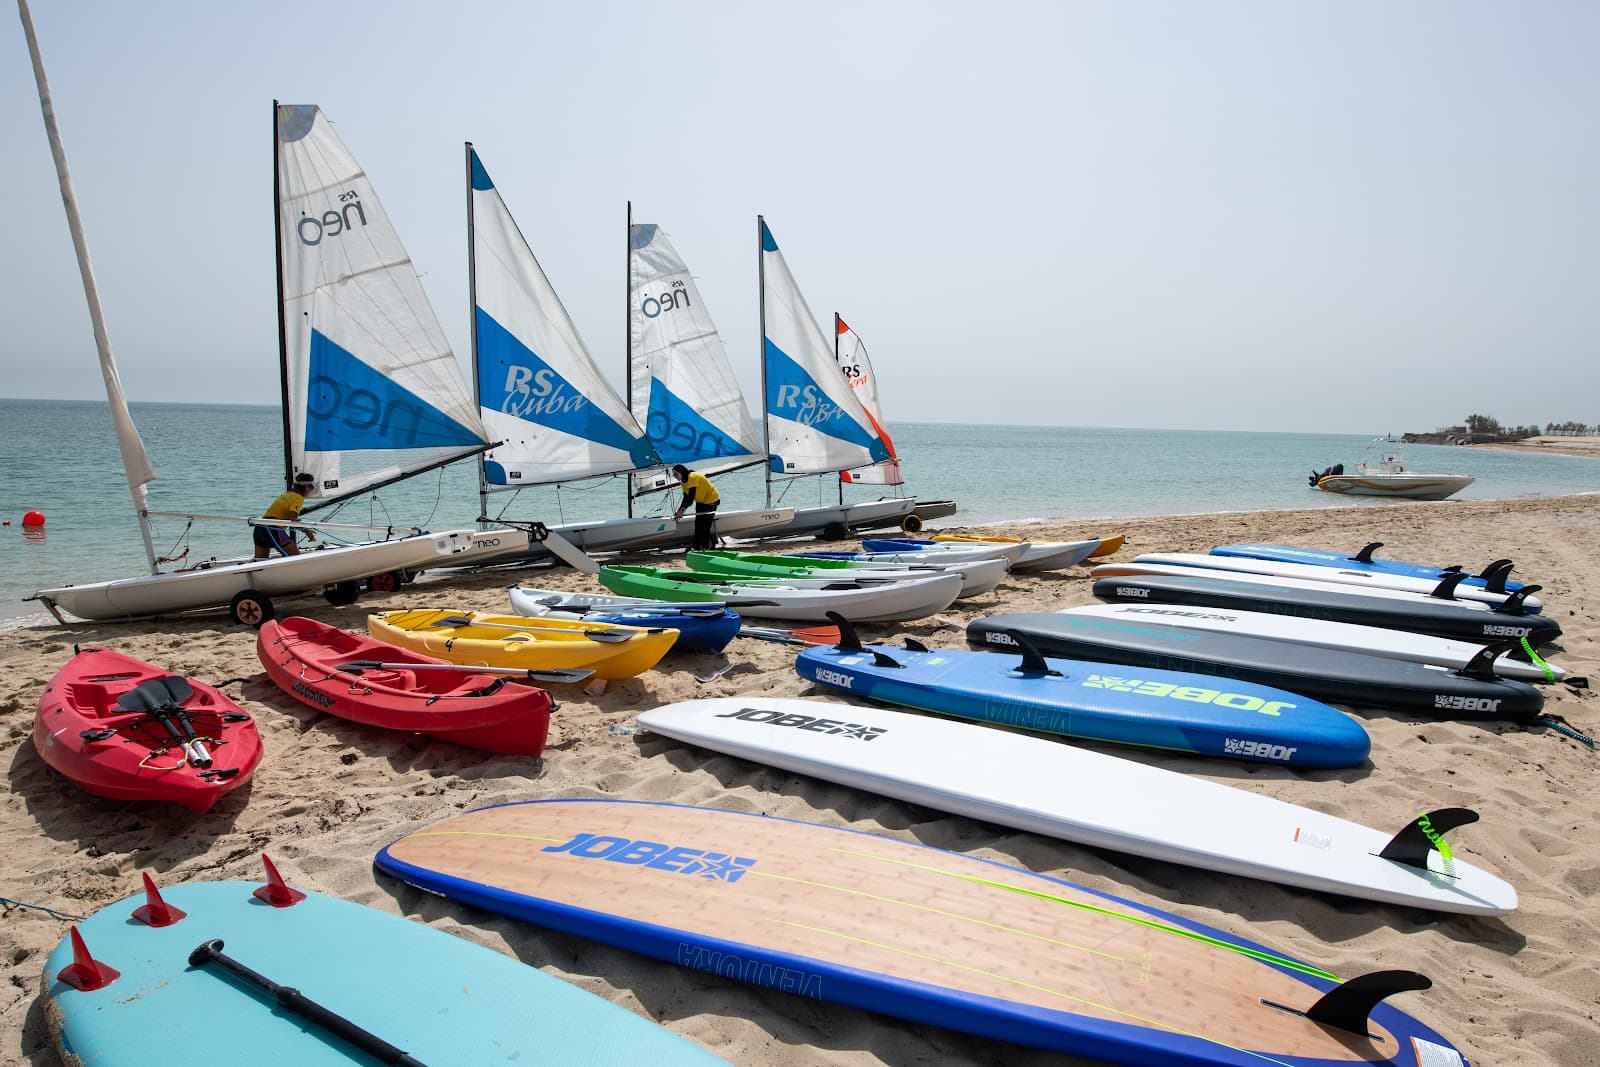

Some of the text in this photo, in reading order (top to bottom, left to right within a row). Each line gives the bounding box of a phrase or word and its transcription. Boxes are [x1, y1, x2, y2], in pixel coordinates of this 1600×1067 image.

[504, 365, 555, 397] RS
[842, 364, 860, 378] RS
[502, 384, 588, 418] Quba
[776, 384, 818, 408] RS
[477, 538, 501, 549] neo
[1124, 587, 1151, 598] JOBE
[1493, 626, 1533, 638] JOBE
[445, 637, 458, 653] 4
[822, 669, 855, 689] JOBE
[1132, 681, 1298, 717] JOBE
[1451, 696, 1502, 713] JOBE
[713, 707, 843, 734] JOBE
[1242, 740, 1298, 761] JOBE
[540, 832, 706, 875] JOBE
